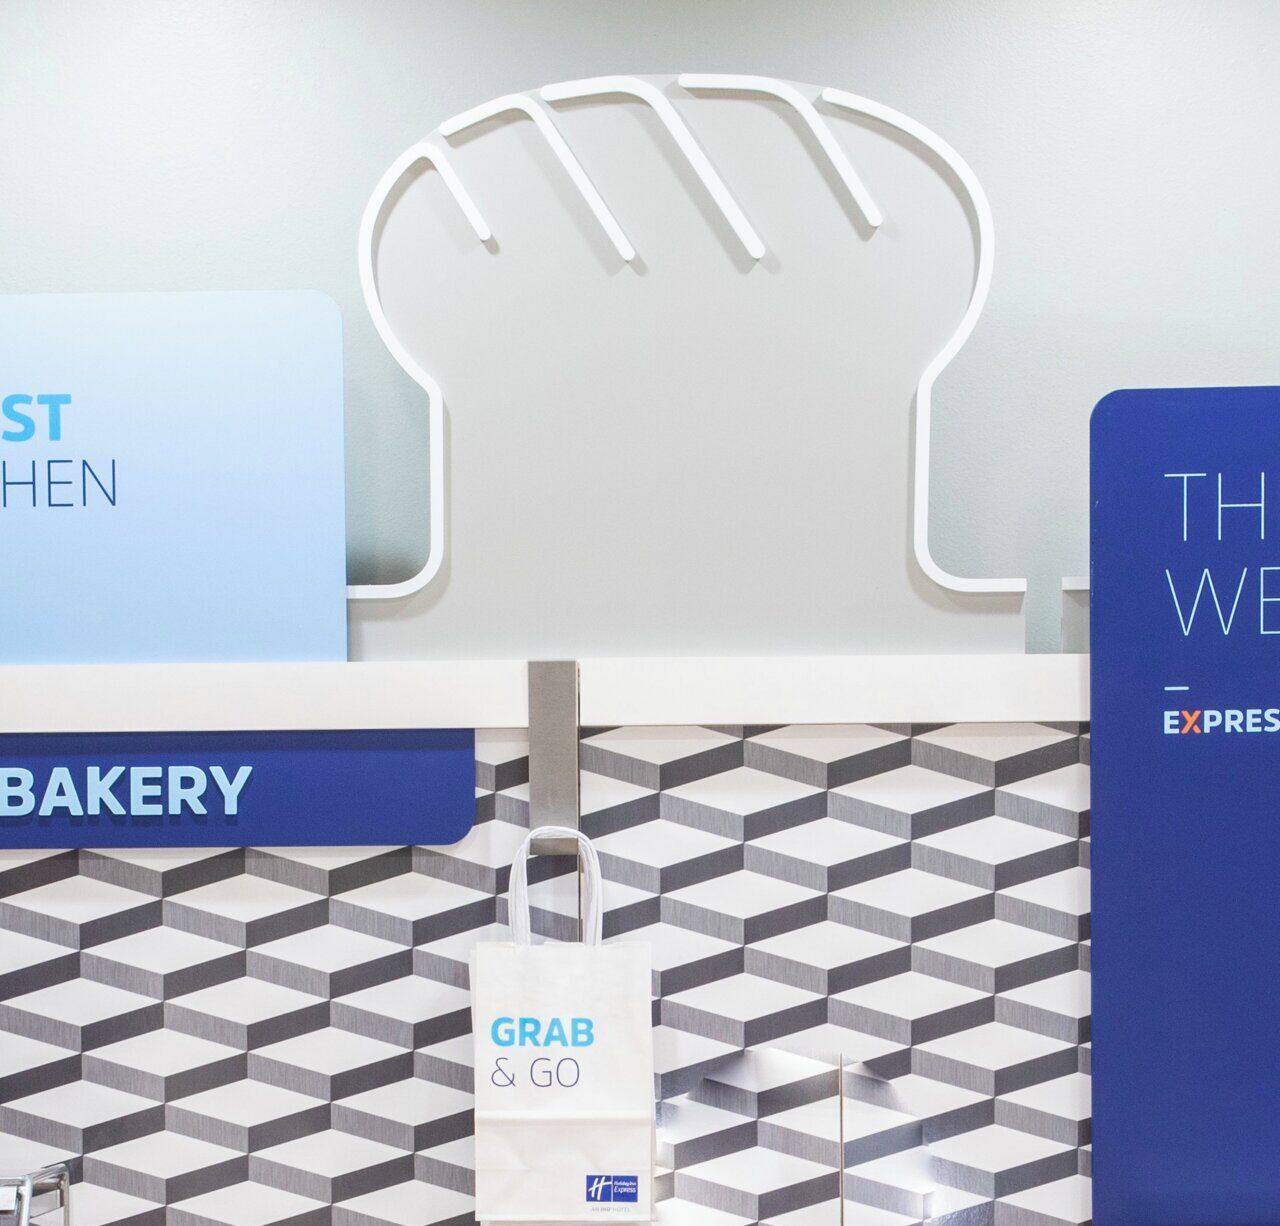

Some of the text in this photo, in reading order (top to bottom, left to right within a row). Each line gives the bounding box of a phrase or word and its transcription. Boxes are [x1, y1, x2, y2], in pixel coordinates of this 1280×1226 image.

[490, 1016, 595, 1047] GRAB
[491, 1057, 580, 1088] & GO
